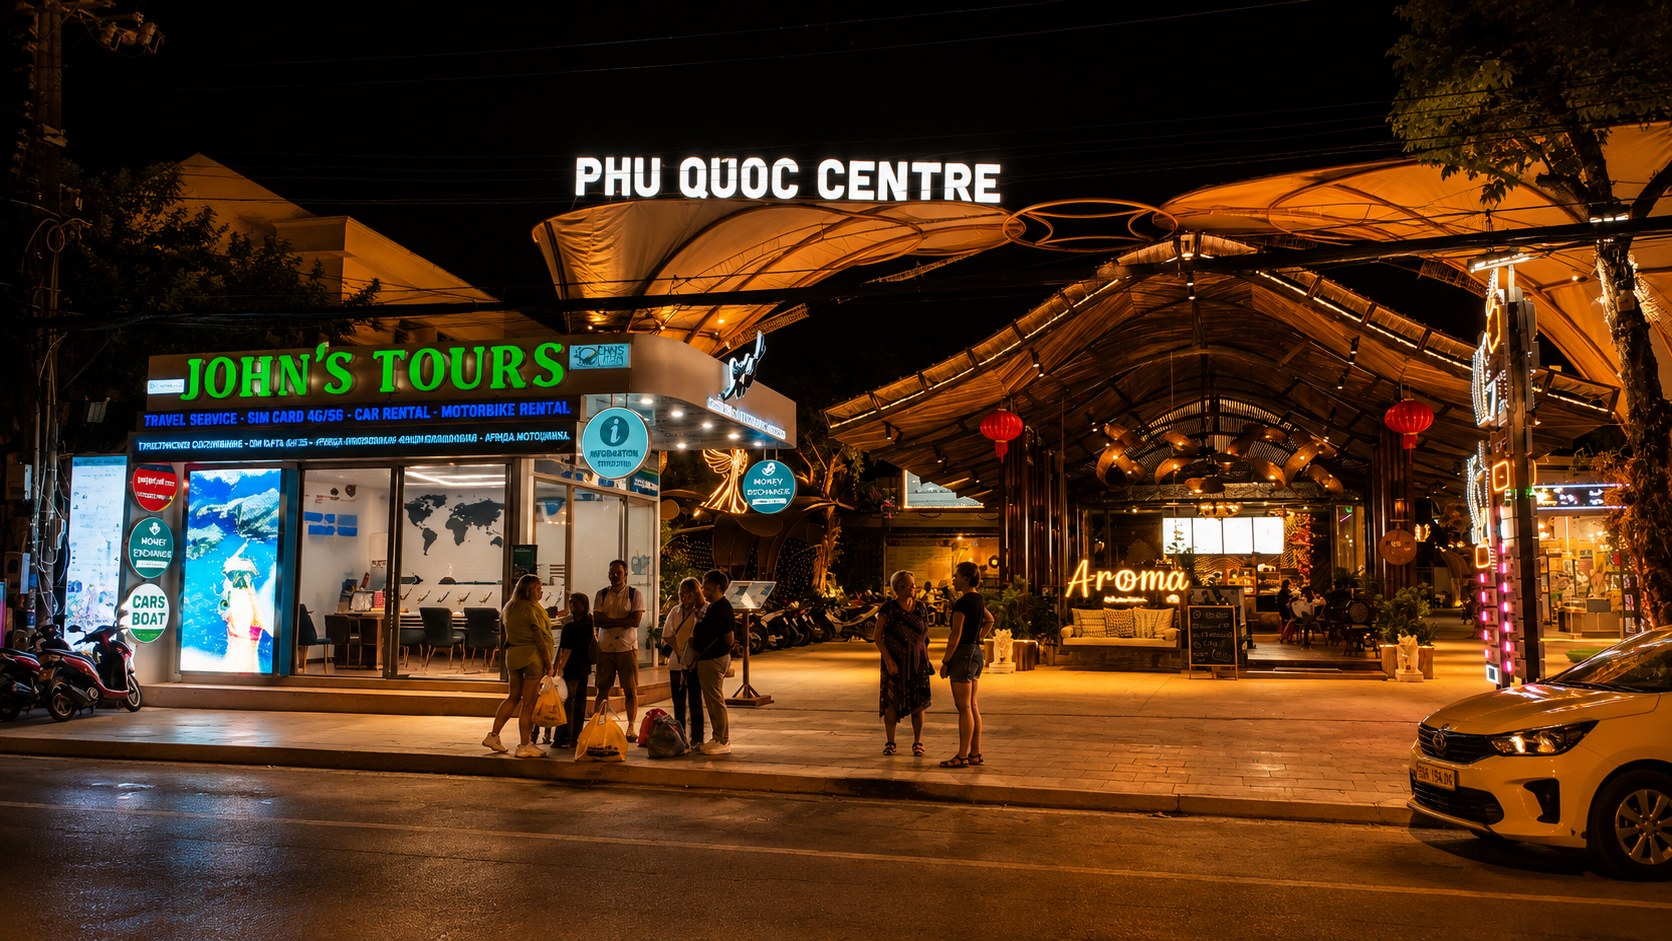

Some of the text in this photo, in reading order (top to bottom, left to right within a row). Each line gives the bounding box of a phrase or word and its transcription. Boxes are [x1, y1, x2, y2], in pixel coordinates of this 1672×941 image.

[576, 157, 1001, 203] PHU QUOC CENTRE
[180, 342, 564, 401] JOHN'S TOURS
[144, 413, 186, 427] TRAVEL
[189, 412, 238, 426] SERVICE
[247, 411, 270, 424] SIM
[272, 409, 304, 424] CARD
[354, 407, 380, 421] CAR
[382, 405, 431, 420] RENTAL
[441, 403, 516, 418] MOTORBIKE
[519, 401, 571, 415] RENTAL
[1065, 559, 1190, 598] Aroma
[132, 594, 165, 609] CARS
[131, 612, 166, 626] BOAT
